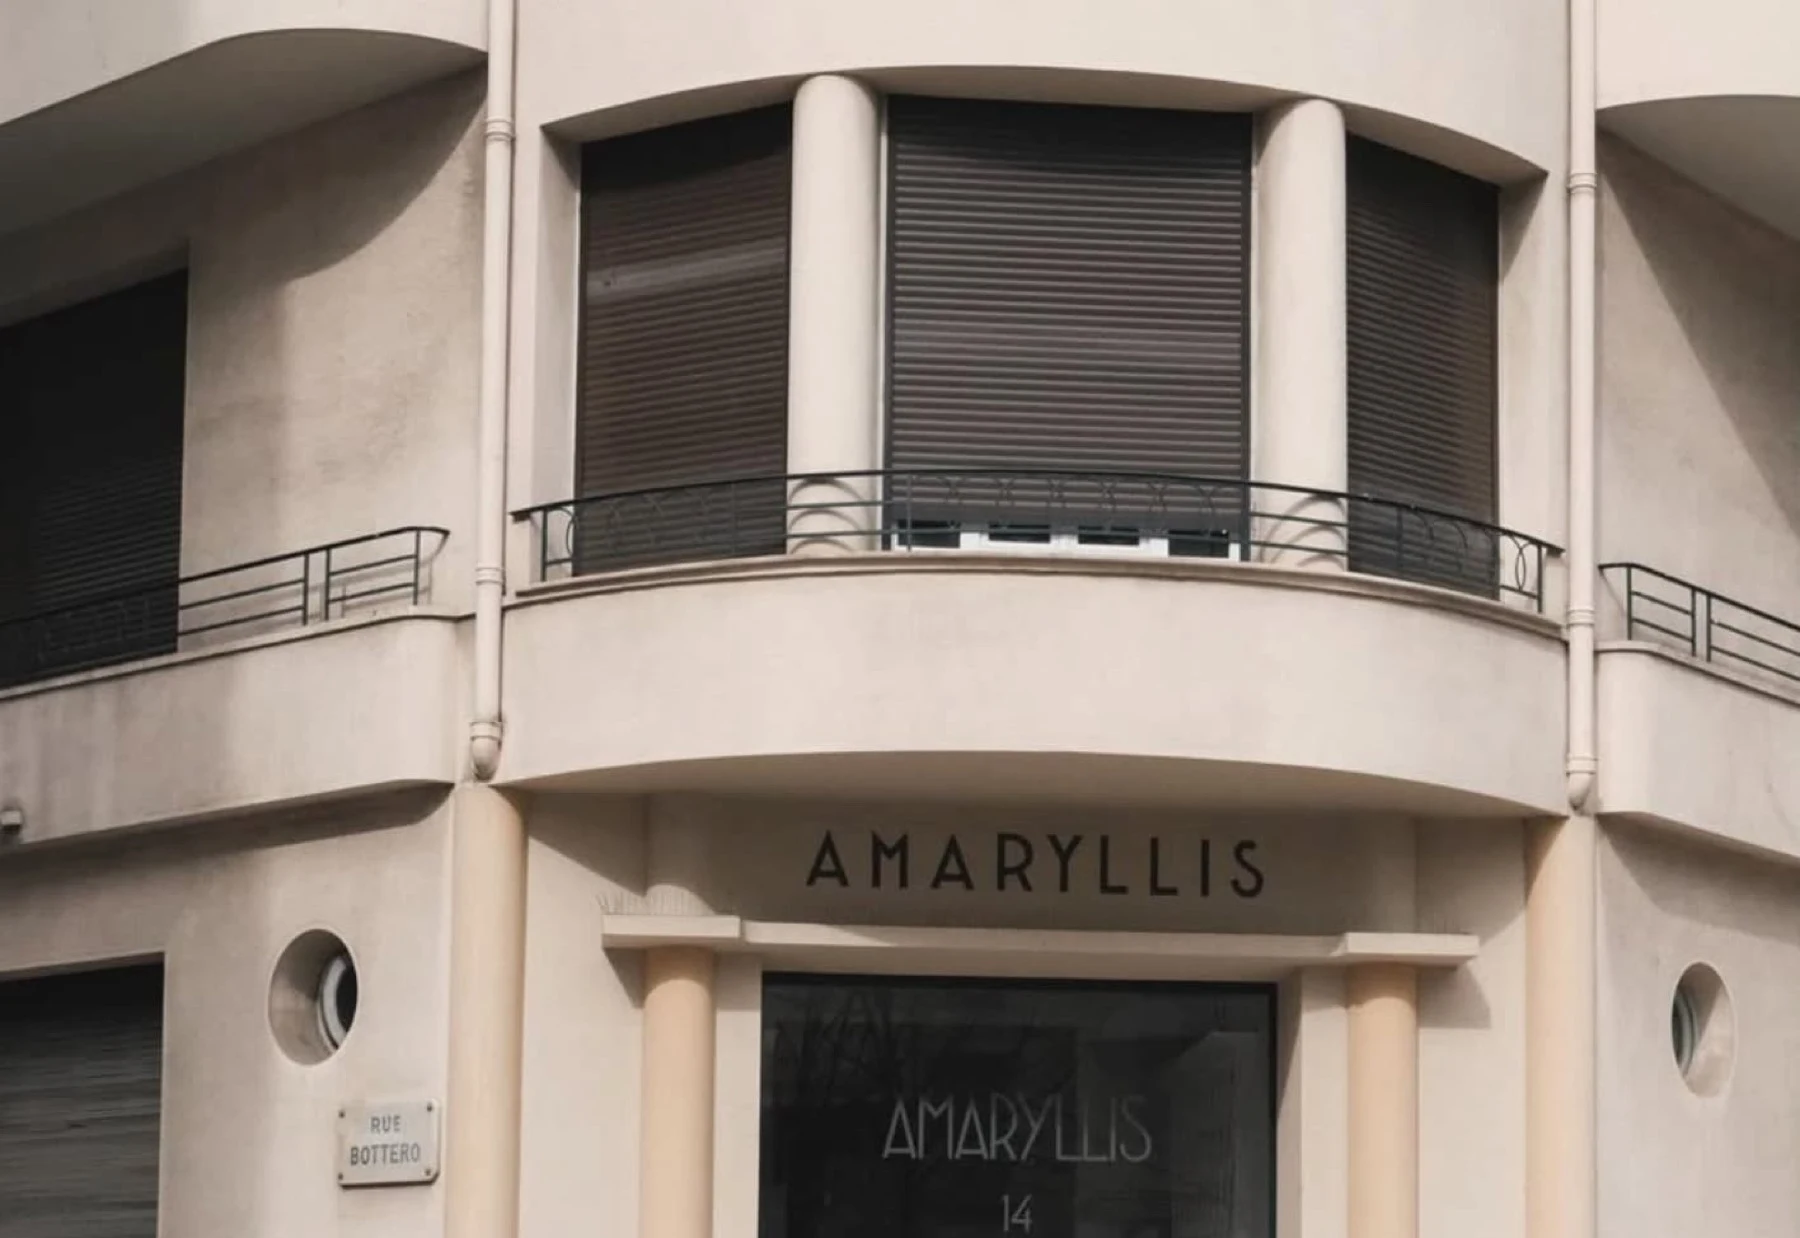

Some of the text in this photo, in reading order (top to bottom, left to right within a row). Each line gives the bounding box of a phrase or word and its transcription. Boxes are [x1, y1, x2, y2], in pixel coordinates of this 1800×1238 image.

[806, 829, 1265, 898] AMARYLLIS
[370, 1114, 401, 1133] RUE
[881, 1092, 1152, 1163] AMARYLLIS
[350, 1142, 421, 1166] BOTTERO
[1002, 1194, 1033, 1233] 14
